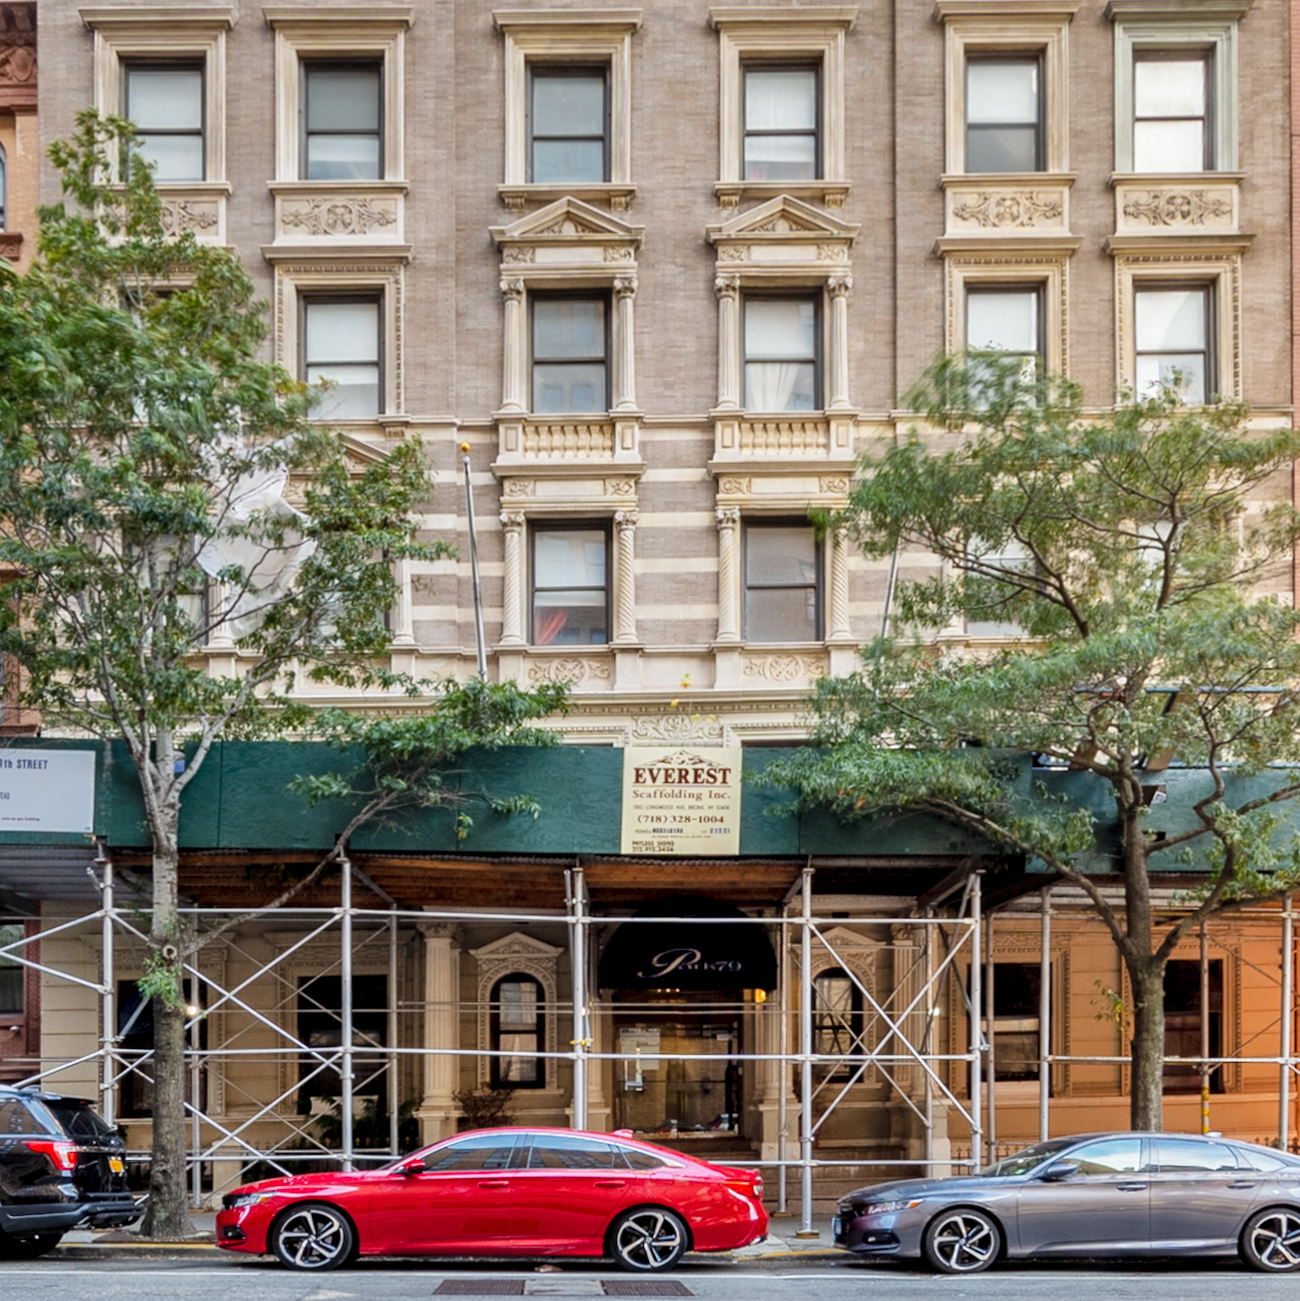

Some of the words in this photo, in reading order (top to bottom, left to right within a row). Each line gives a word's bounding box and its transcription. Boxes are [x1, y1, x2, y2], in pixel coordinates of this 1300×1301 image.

[16, 759, 48, 770] STREET
[633, 767, 732, 785] EVEREST
[632, 789, 703, 801] Scaffolding
[708, 790, 731, 799] Inc.
[637, 815, 668, 824] (718)
[669, 815, 725, 824] 328-1004
